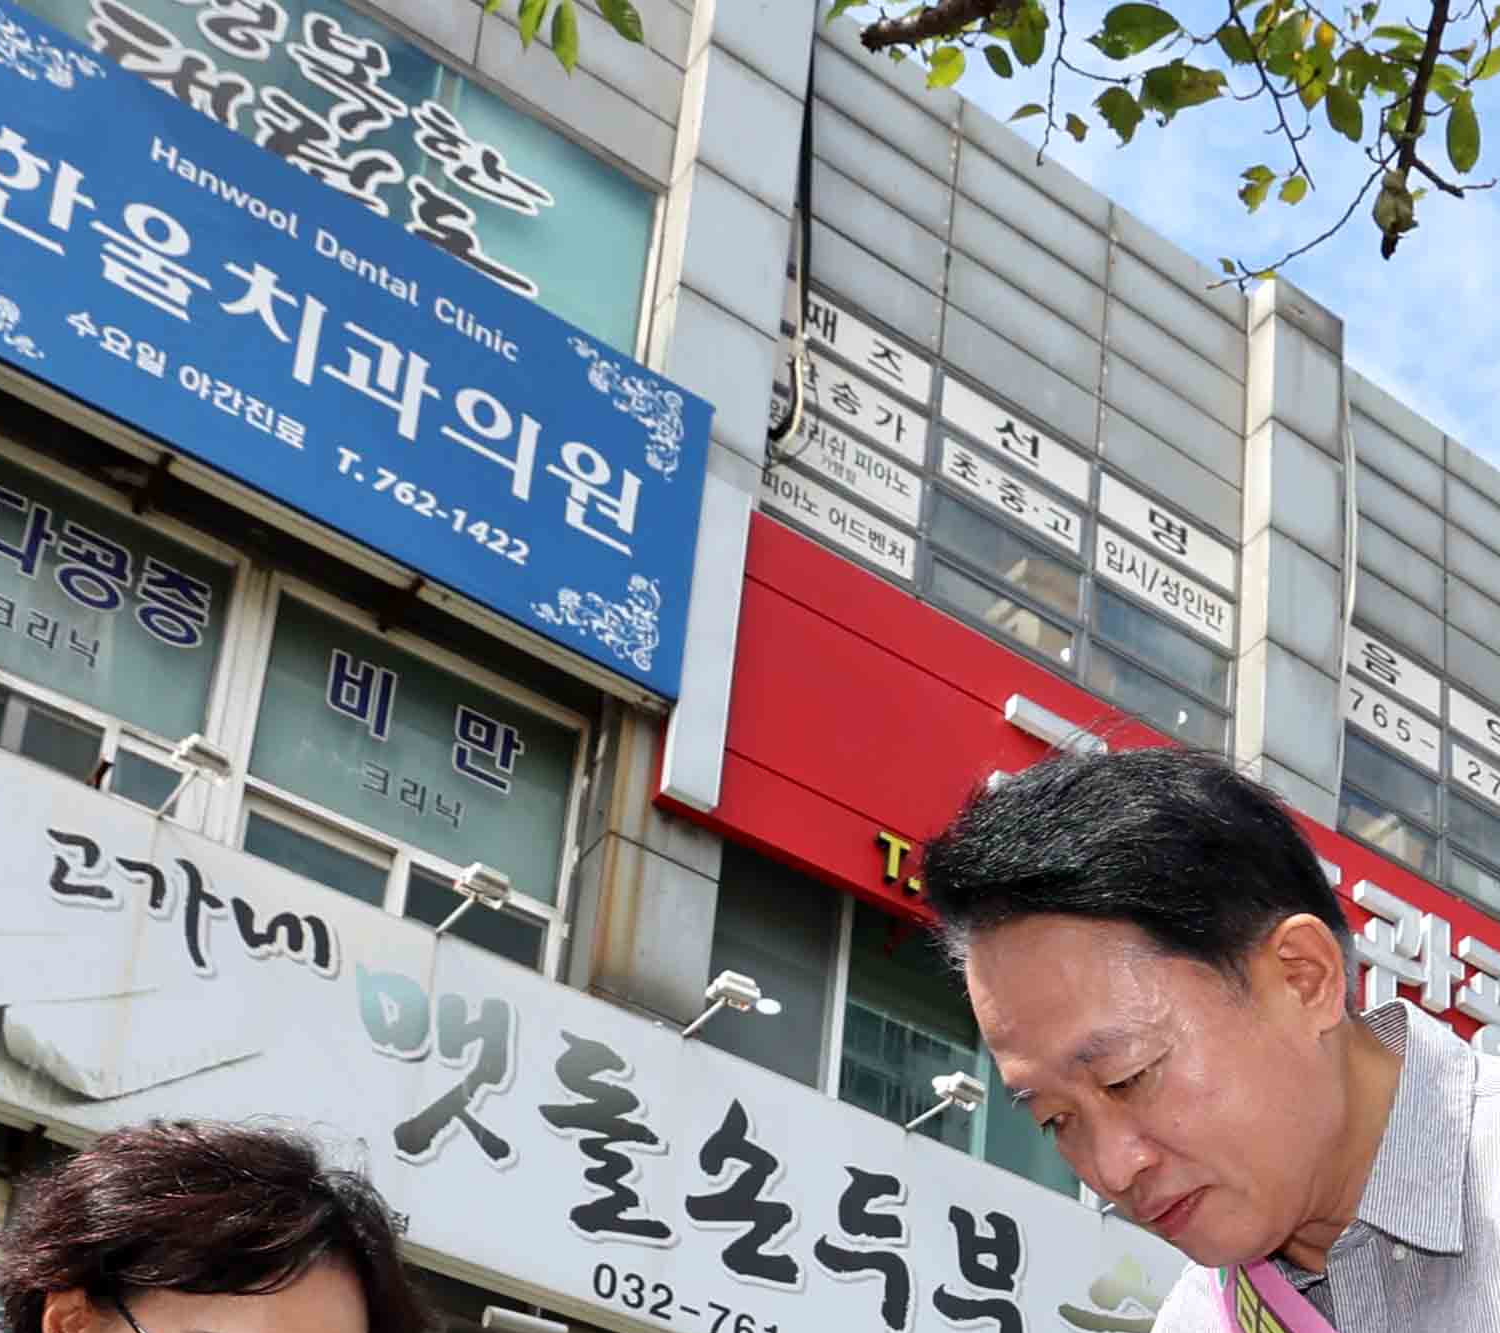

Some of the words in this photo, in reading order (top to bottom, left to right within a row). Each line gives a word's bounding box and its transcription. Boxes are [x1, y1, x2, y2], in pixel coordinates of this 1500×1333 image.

[151, 136, 301, 240] Hanwool
[315, 229, 421, 307] Dental
[434, 296, 521, 364] Clinic
[66, 310, 169, 378] 수요일
[178, 365, 306, 452] 야간진료
[1104, 540, 1225, 633] 입시/성인반
[1148, 507, 1190, 556] 명
[1361, 640, 1402, 688] 음
[361, 759, 465, 832] 크리닉
[45, 828, 342, 980] 고가네
